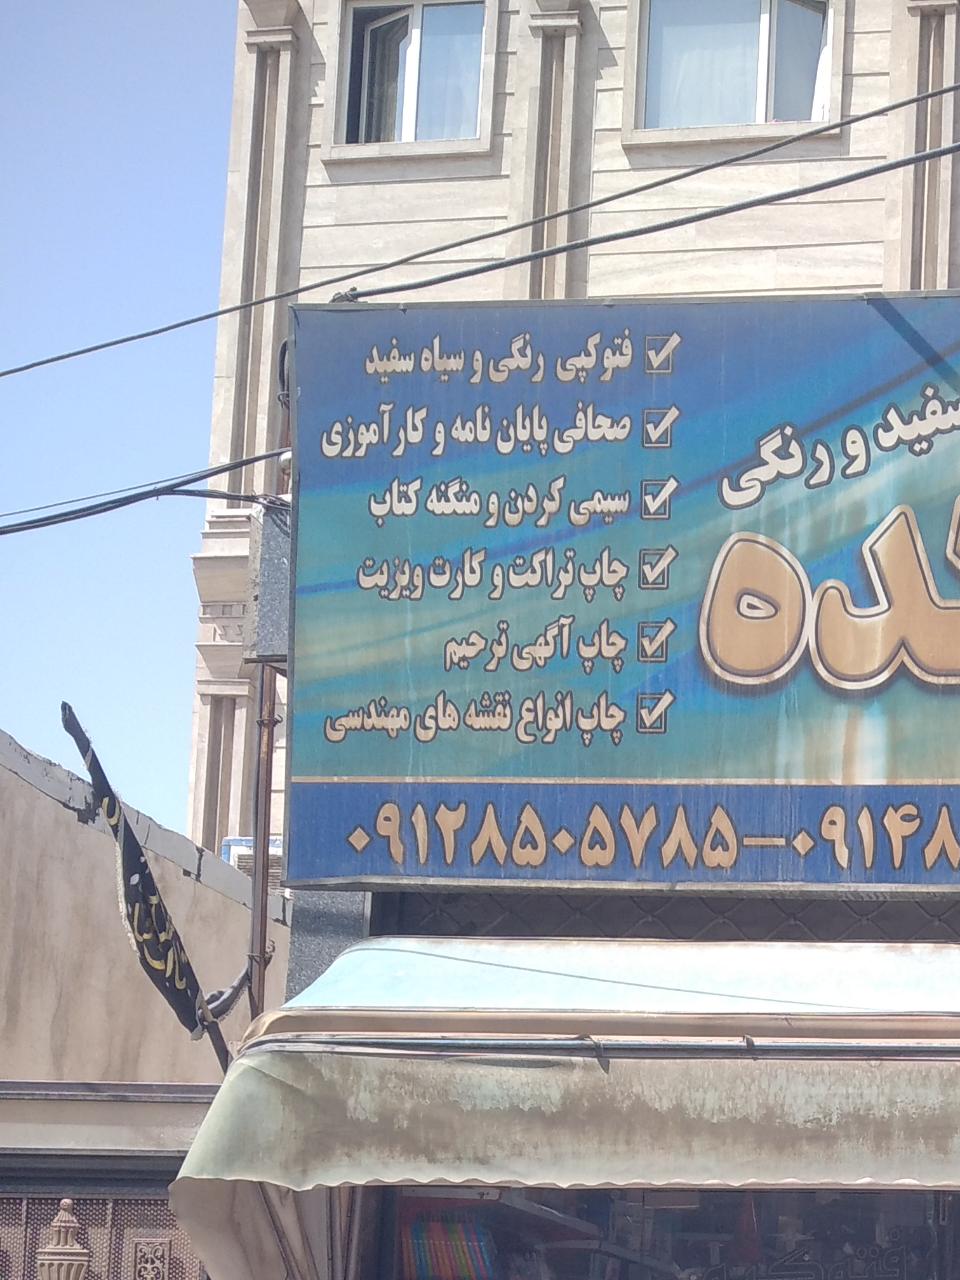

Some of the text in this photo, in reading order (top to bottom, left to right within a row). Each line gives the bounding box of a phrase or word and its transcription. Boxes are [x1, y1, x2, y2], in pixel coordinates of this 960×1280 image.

[365, 329, 633, 384] فتوکپی رنگی و سیاه سفید
[321, 401, 633, 458] صحافی پایان نامه و کار آموزی
[841, 426, 870, 477] و
[717, 423, 835, 509] رنگی
[369, 476, 631, 527] سیمی کردن و منگنه کتاب
[357, 546, 628, 601] چاپ تراکت و کارت ویزیت
[444, 615, 628, 673] چاپ آگهی ترحیم
[324, 690, 626, 746] چاپ انواع نقشه های مهندسی
